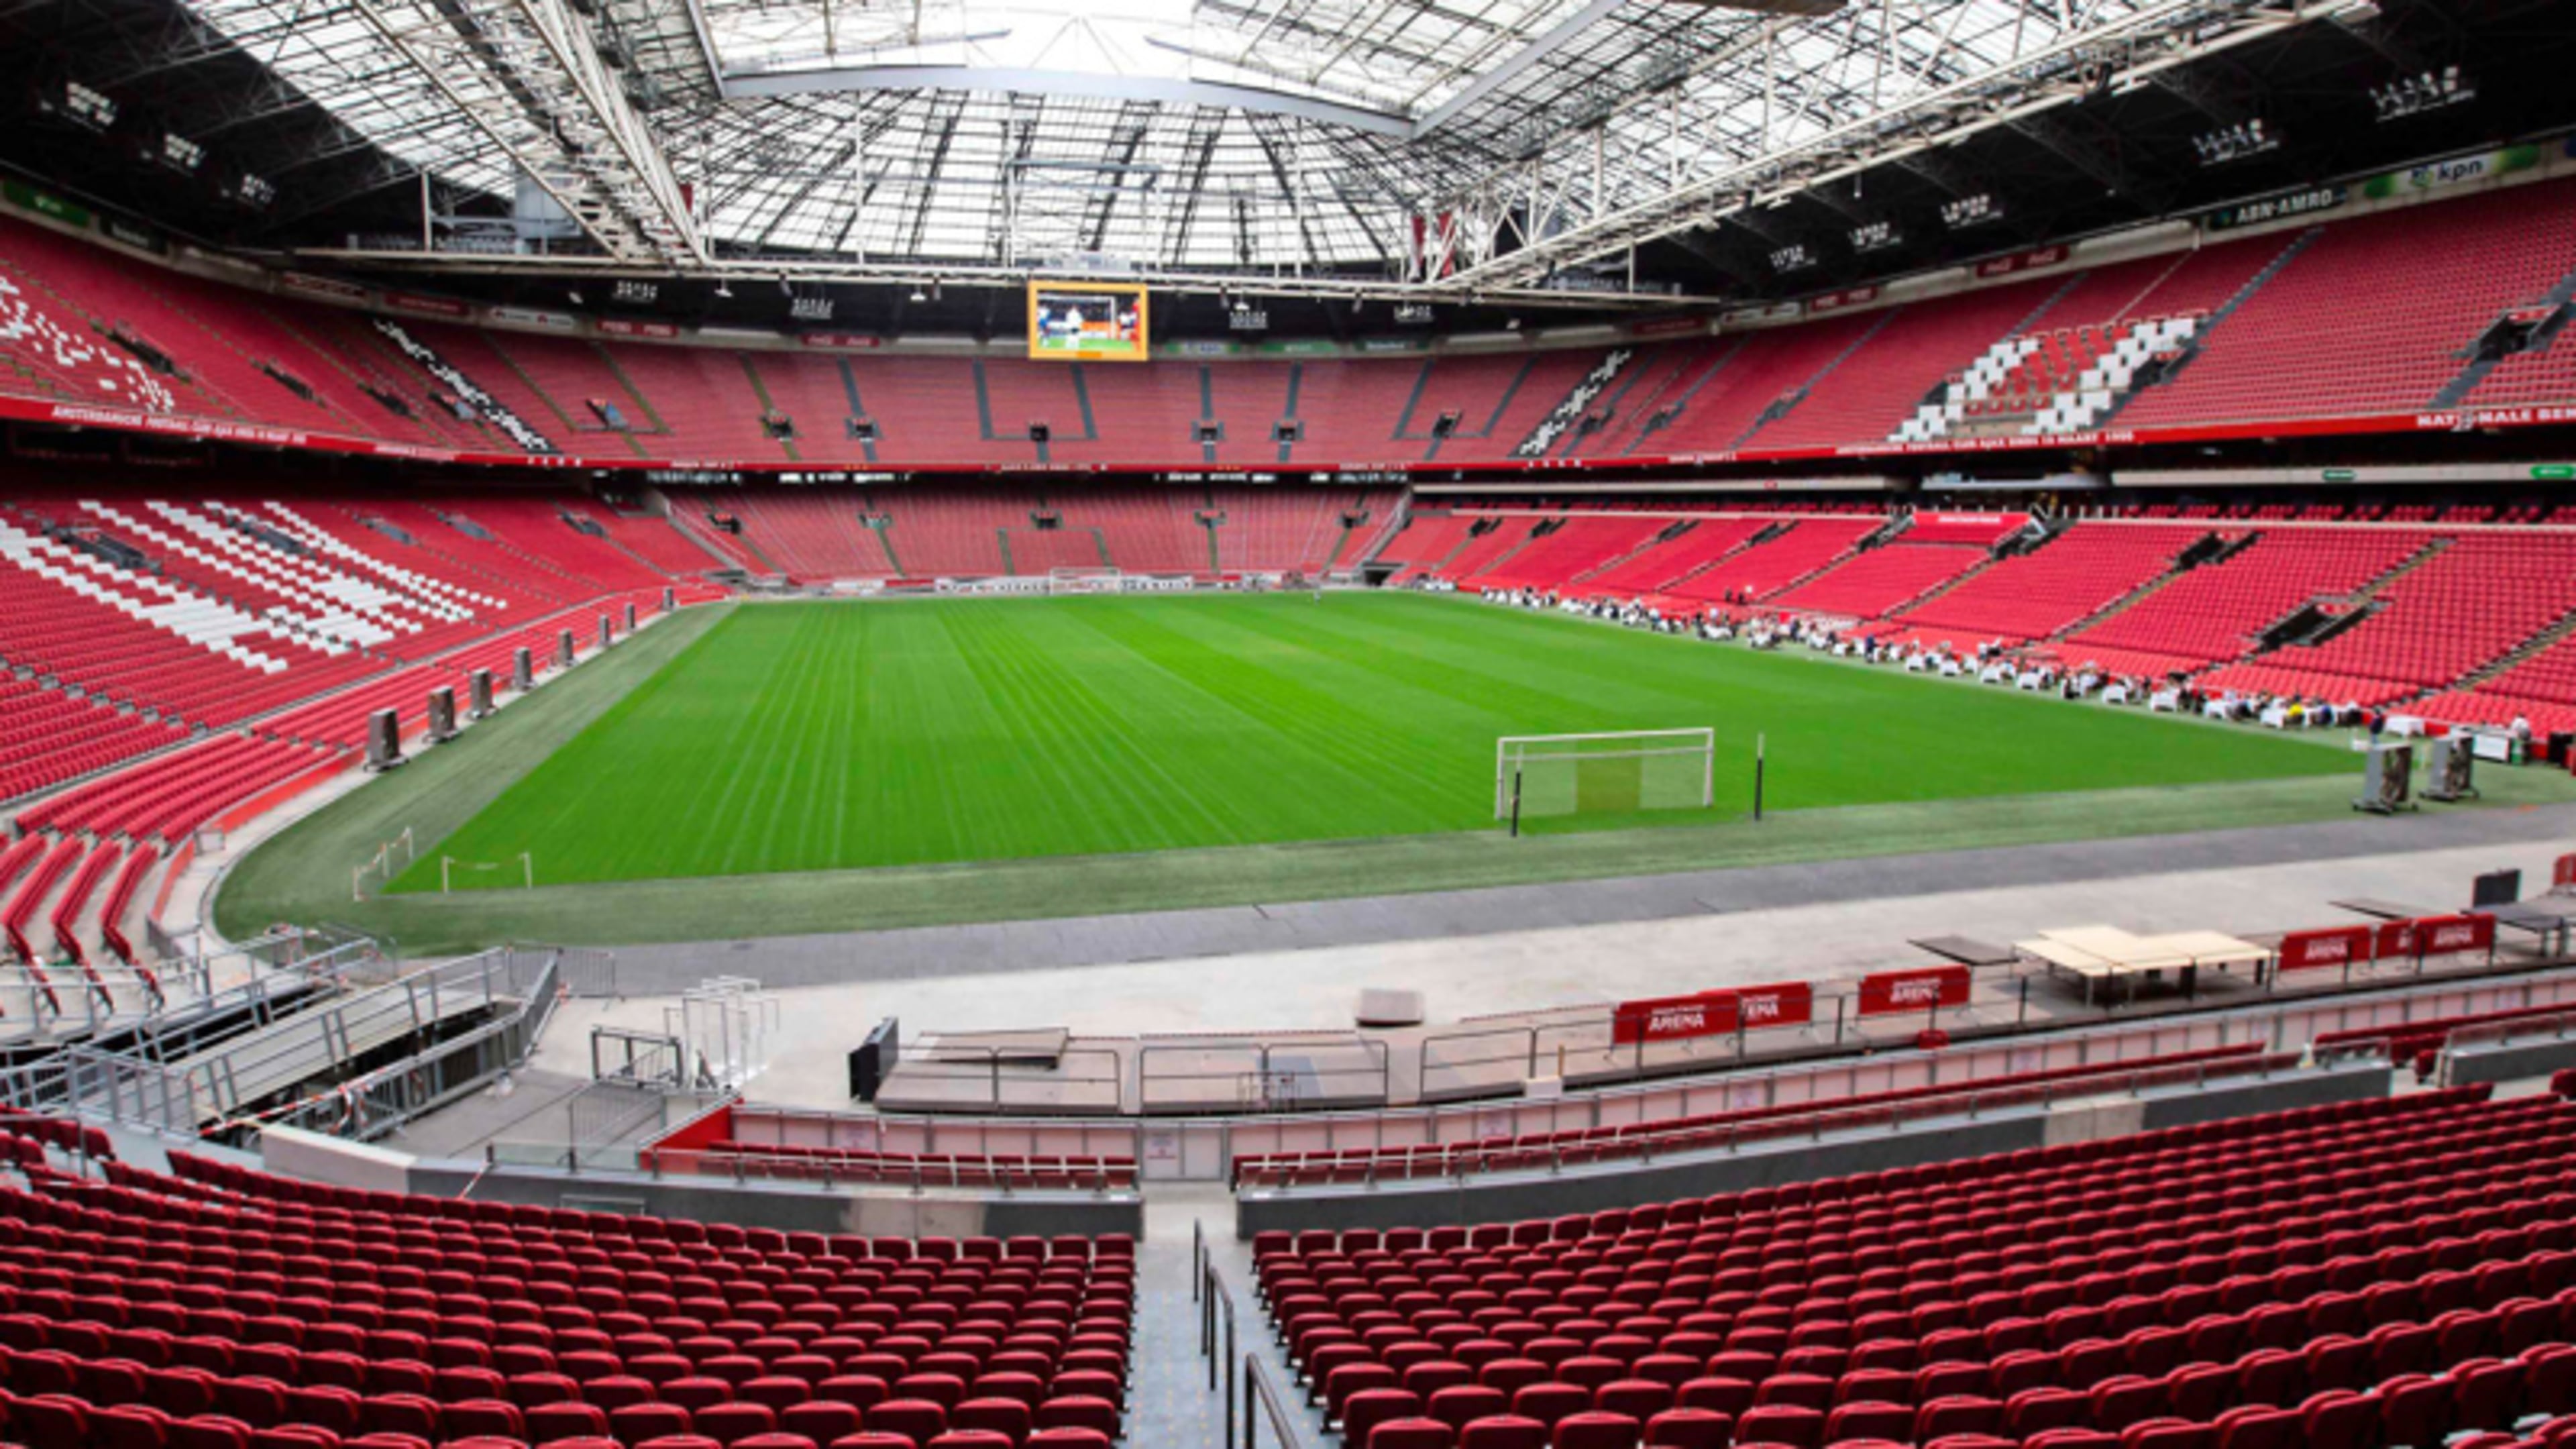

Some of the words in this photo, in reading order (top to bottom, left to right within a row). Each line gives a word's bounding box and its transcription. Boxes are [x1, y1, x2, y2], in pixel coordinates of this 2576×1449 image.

[2436, 160, 2483, 182] kpn
[2236, 189, 2332, 224] ABN-AMRO
[2417, 409, 2531, 427] NATNALE
[1648, 1012, 1705, 1032] ARENA
[1747, 1000, 1779, 1022] ENA
